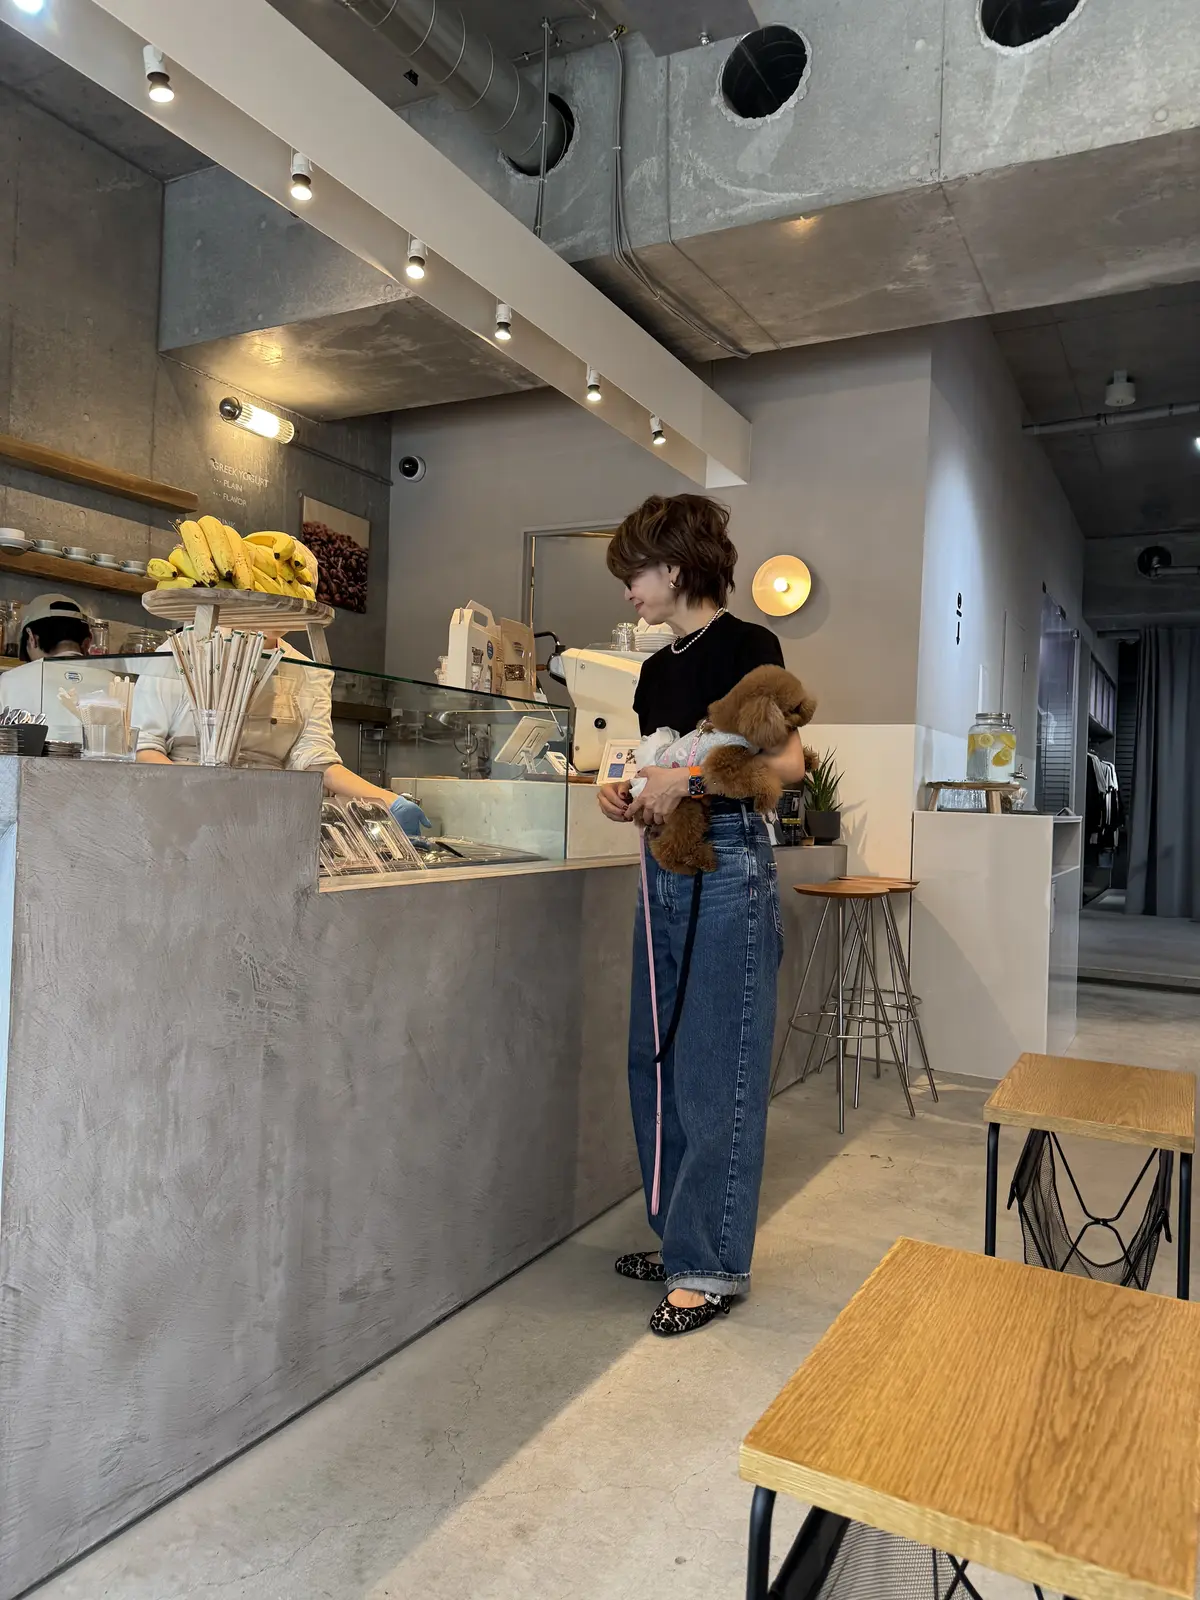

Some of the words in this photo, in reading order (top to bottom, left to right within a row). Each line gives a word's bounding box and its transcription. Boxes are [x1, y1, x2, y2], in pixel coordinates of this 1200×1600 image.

[212, 461, 238, 476] GREEK
[239, 470, 269, 488] YOGURT
[223, 480, 243, 492] PLAIN
[222, 493, 247, 507] FLAVOR
